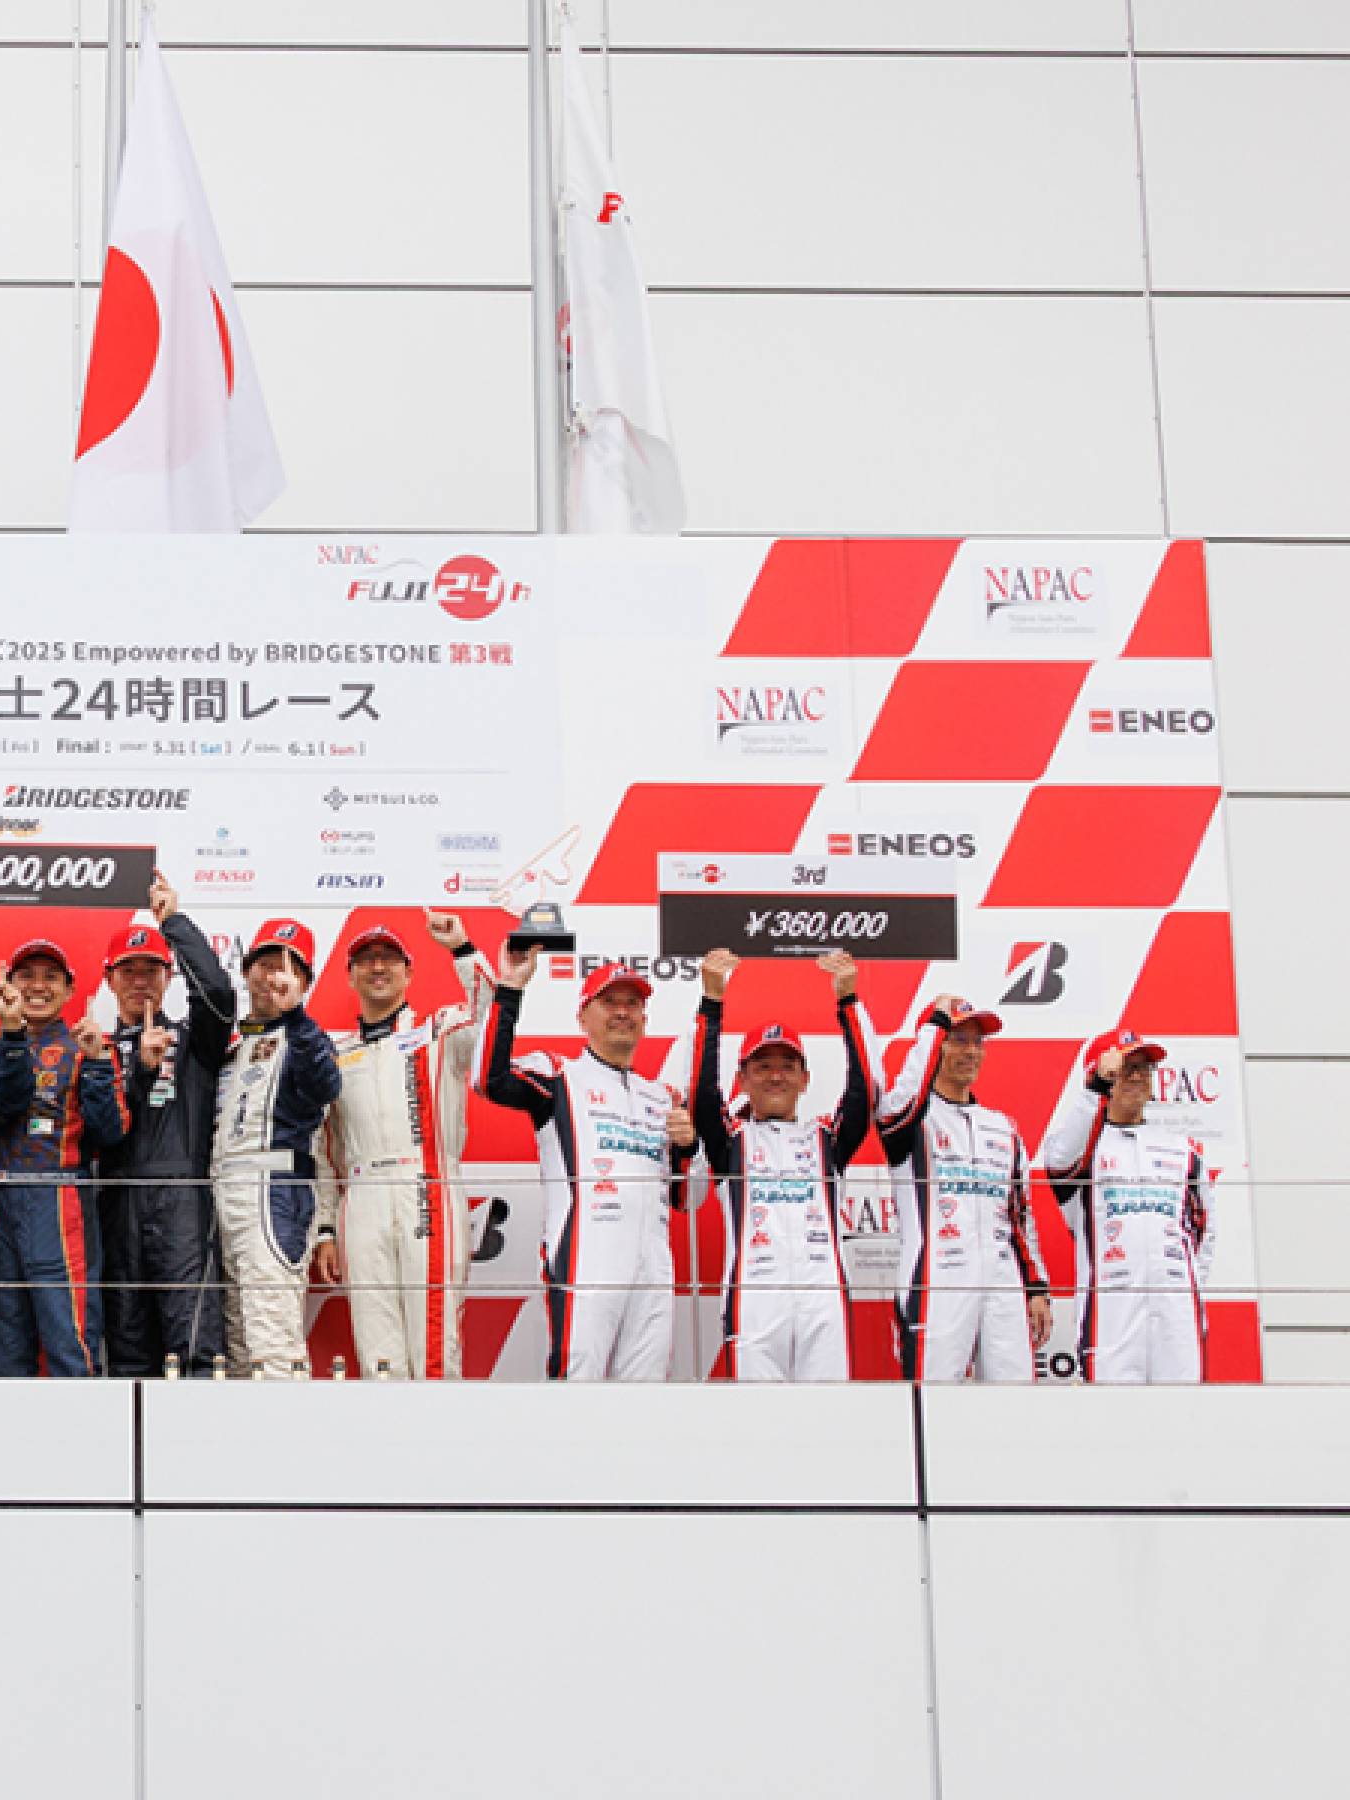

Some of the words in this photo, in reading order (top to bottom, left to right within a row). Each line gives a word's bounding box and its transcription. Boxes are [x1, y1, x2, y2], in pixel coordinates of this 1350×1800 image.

[984, 566, 1095, 602] NAPAC
[72, 641, 221, 667] Empowered
[227, 642, 258, 667] by
[264, 643, 441, 665] BRIDGESTONE
[716, 686, 826, 722] NAPAC
[1118, 708, 1216, 735] ENEO
[3, 785, 191, 811] BRIDGESTONE
[857, 833, 977, 858] ENEOS
[791, 865, 827, 886] 3rd
[743, 910, 889, 941] ¥360,000
[1151, 1064, 1222, 1105] PAC
[839, 1196, 898, 1233] NAP
